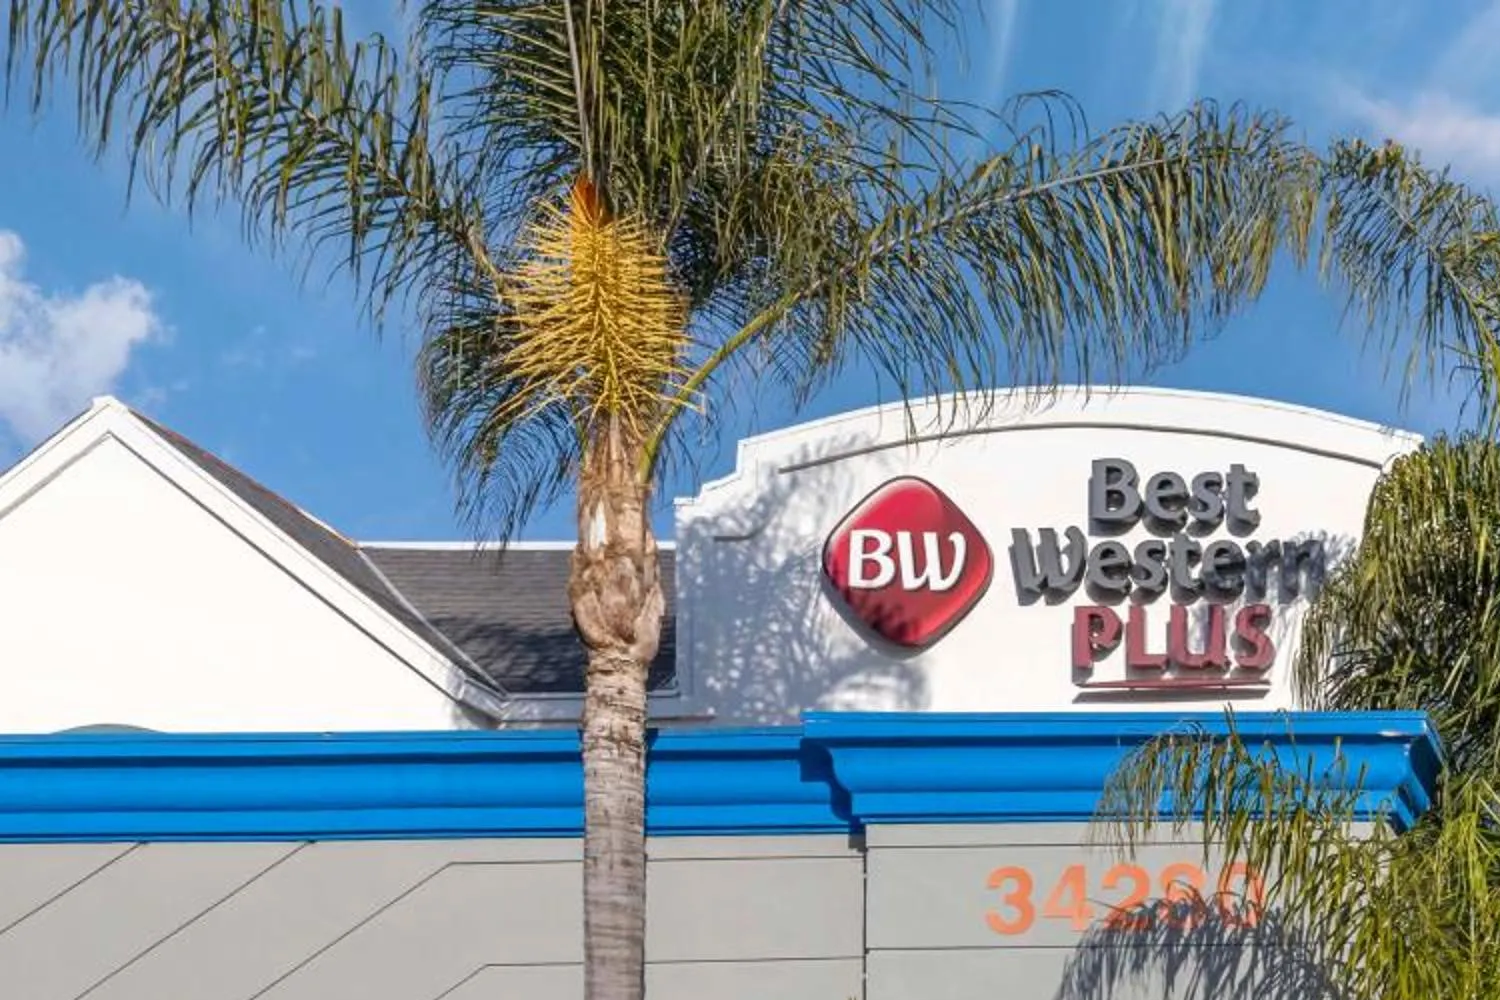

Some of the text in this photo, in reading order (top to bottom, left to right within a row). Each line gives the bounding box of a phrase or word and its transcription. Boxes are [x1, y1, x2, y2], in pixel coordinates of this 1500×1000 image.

[1089, 458, 1259, 536] Best
[847, 528, 966, 592] BW
[1009, 525, 1325, 606] Western
[1071, 603, 1277, 682] PLUS
